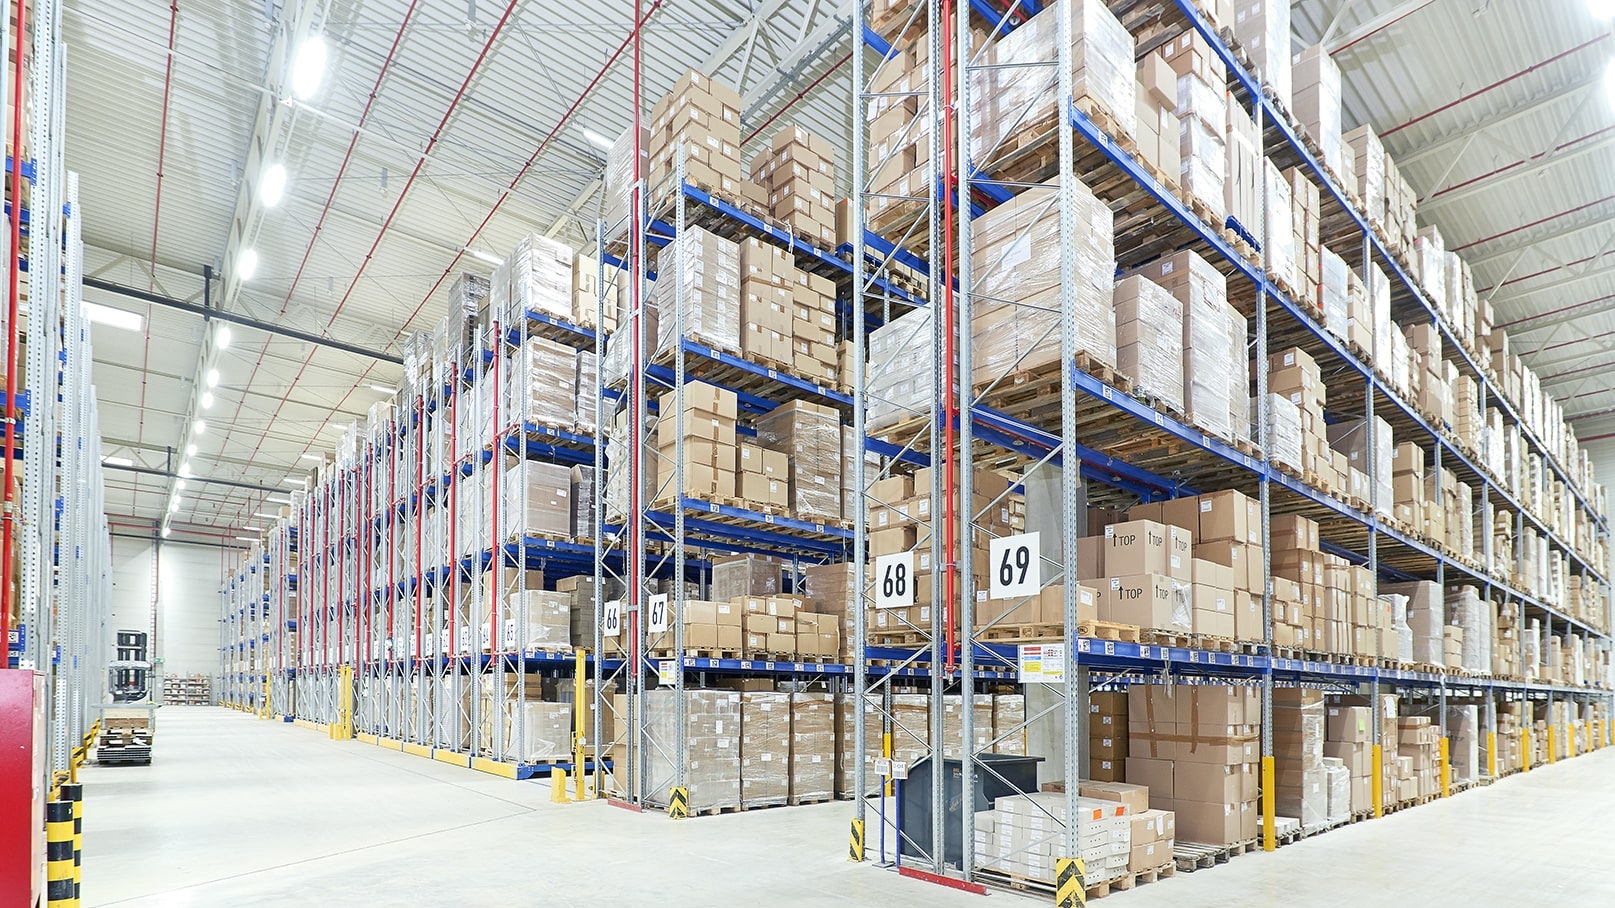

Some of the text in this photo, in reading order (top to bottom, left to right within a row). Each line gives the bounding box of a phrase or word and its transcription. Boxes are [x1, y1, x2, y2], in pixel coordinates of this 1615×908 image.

[1119, 534, 1136, 546] TOP
[1152, 535, 1163, 547] TOP
[1178, 540, 1188, 552] TOP
[1000, 546, 1029, 586] 69
[883, 563, 906, 598] 68
[1125, 588, 1143, 600] TOP
[1159, 588, 1169, 600] TOP
[607, 608, 617, 630] 66
[652, 601, 665, 625] 67
